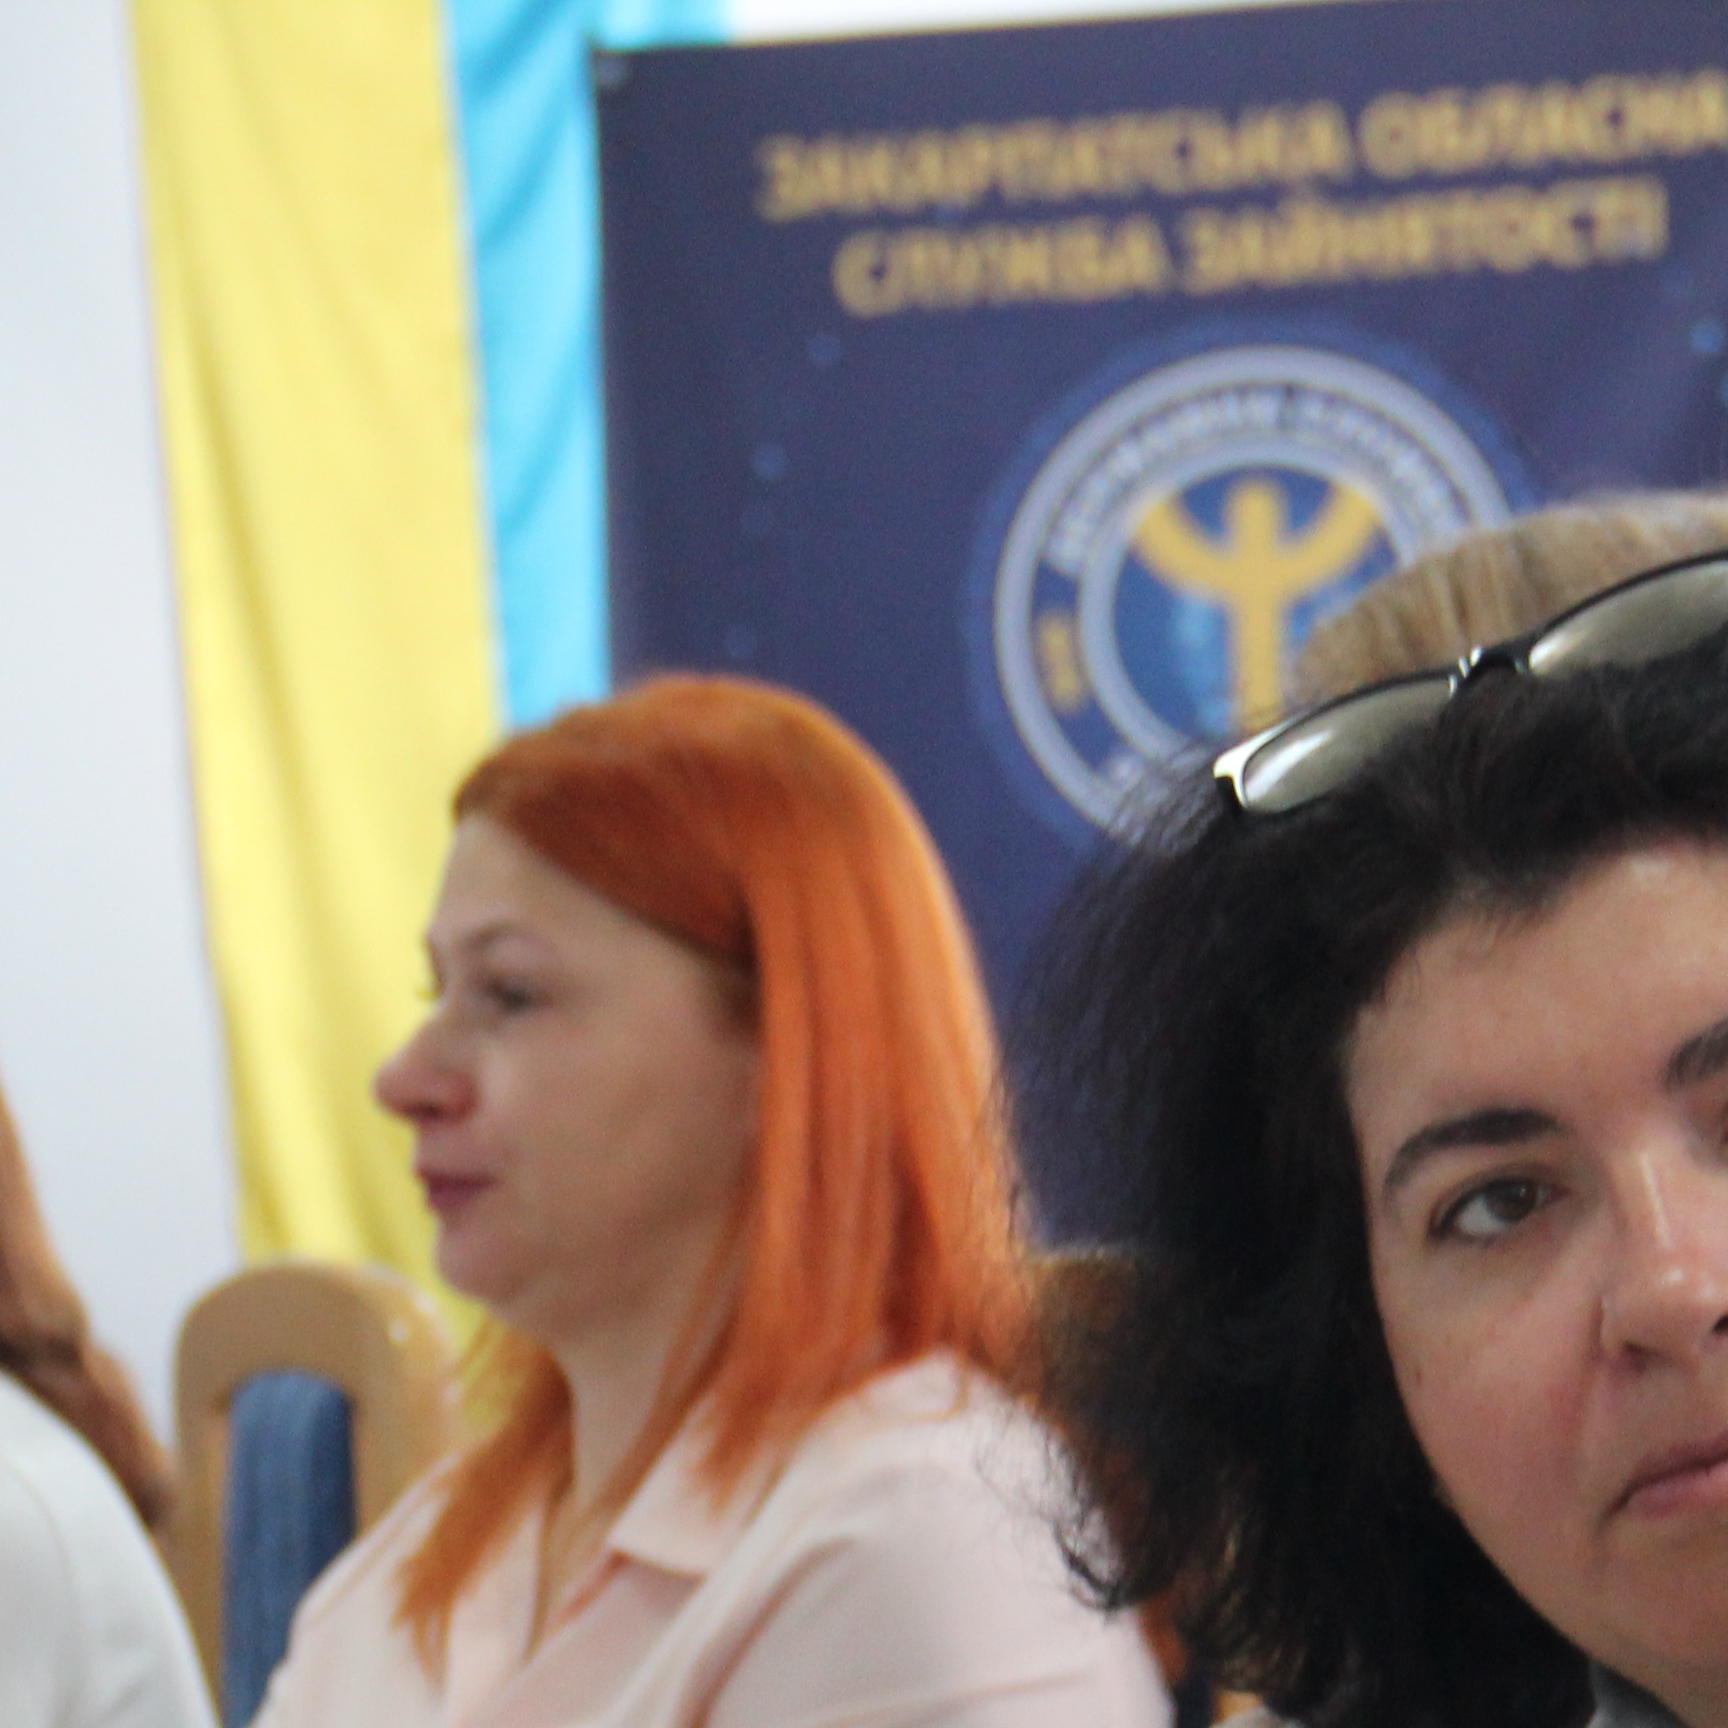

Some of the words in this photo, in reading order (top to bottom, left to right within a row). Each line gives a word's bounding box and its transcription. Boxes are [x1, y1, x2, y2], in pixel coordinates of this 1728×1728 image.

[758, 101, 1353, 221] ЗАКАРПАТСЬКА
[833, 214, 1174, 318] СЛУЖБА
[1176, 174, 1669, 295] ЗАЙНЯТОСТІ
